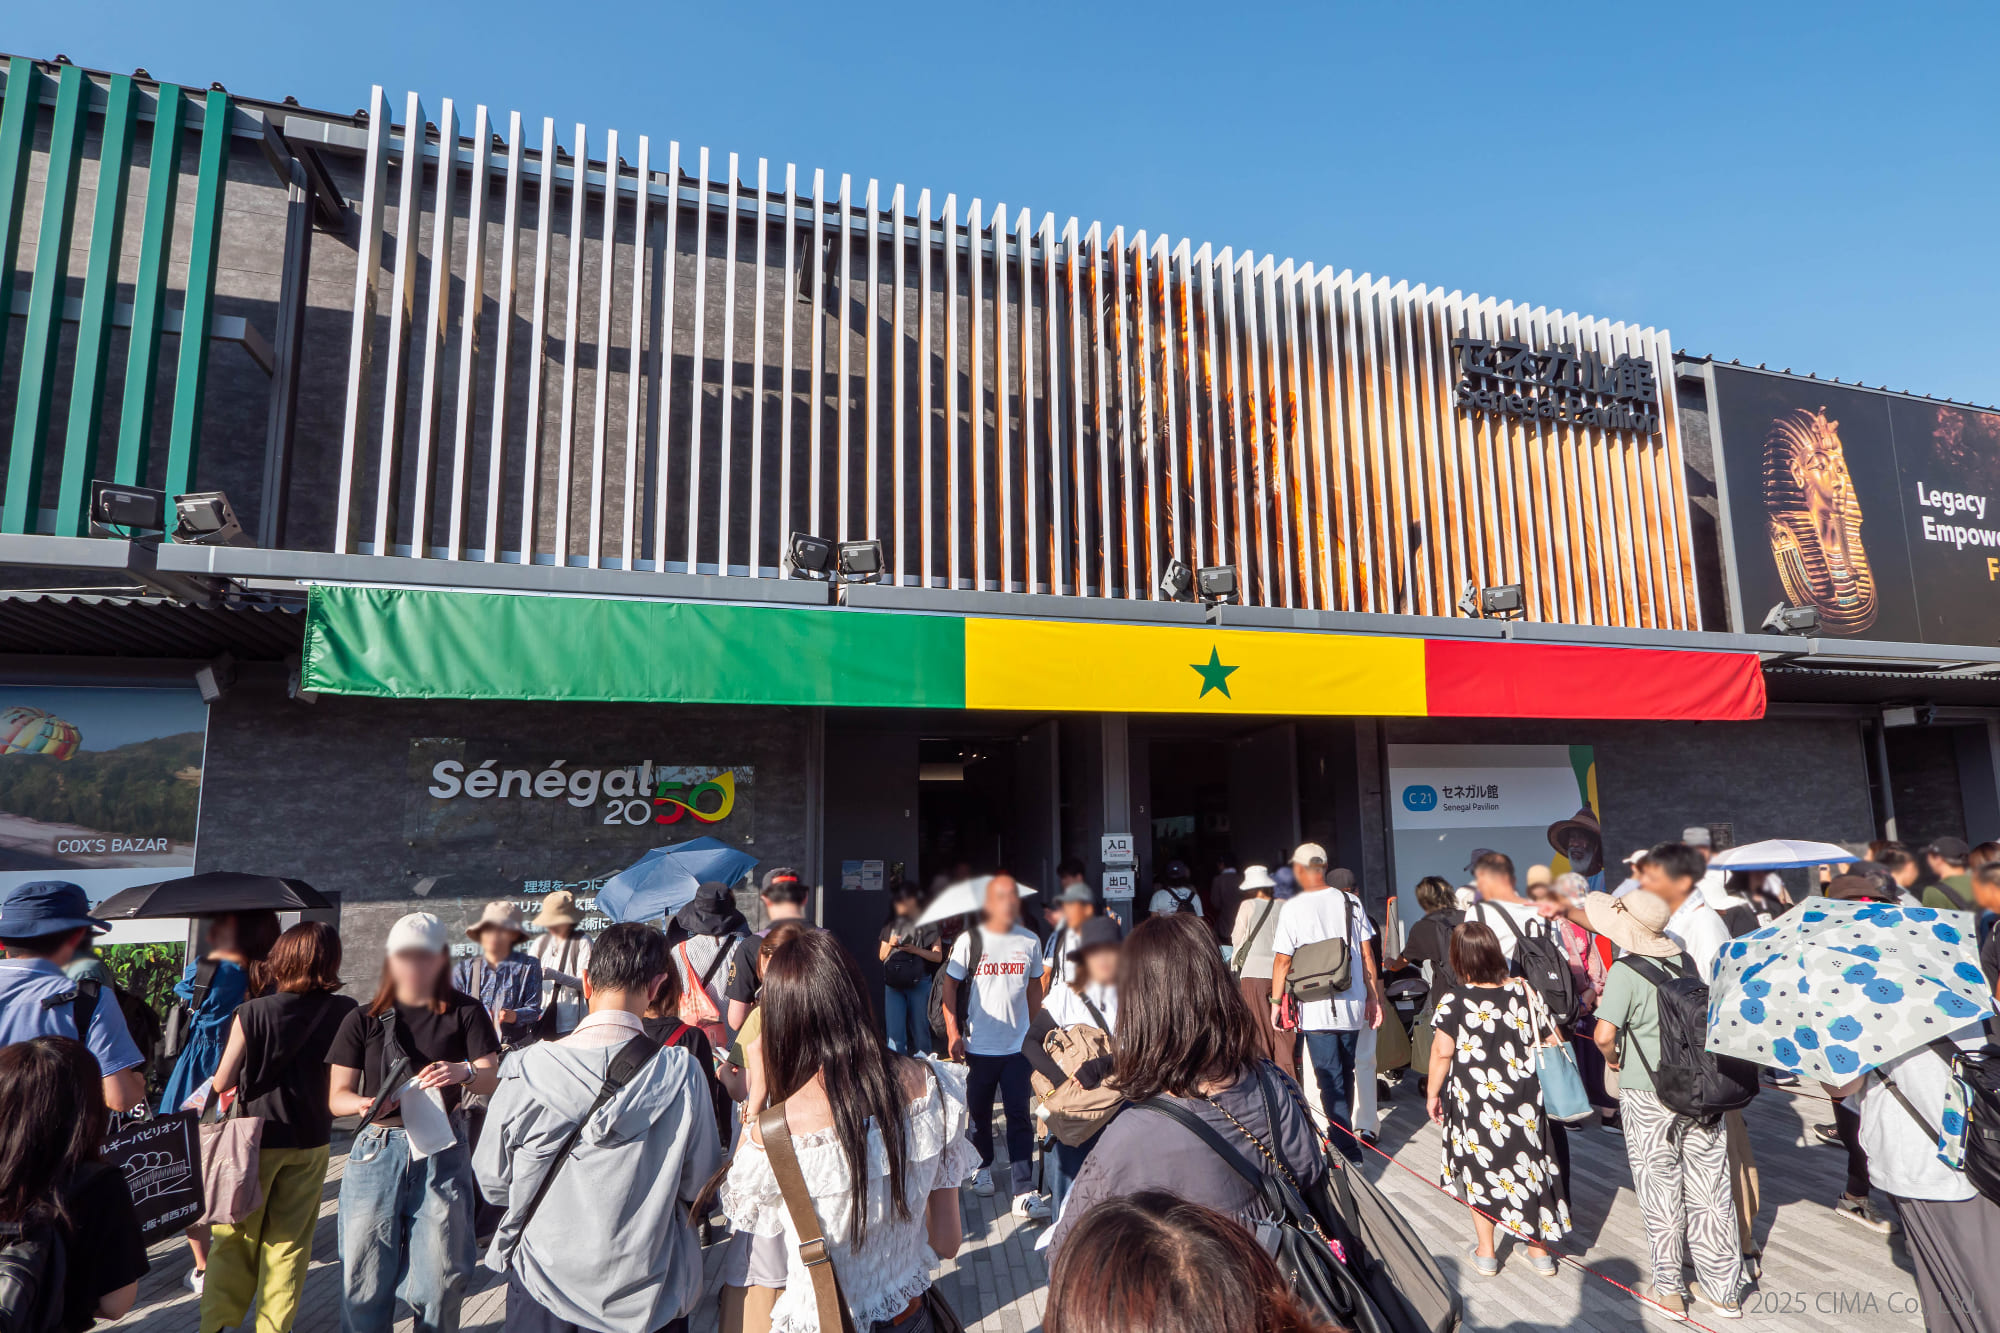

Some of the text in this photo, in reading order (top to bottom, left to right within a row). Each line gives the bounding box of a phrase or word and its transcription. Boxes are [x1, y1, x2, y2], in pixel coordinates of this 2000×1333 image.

[1451, 330, 1656, 402] セネガル館
[1455, 380, 1660, 434] Senegal Pavilion
[1917, 481, 1986, 519] Legacy
[1986, 557, 2000, 581] F
[428, 759, 653, 807] Sénégal
[1409, 793, 1432, 804] C 21
[1442, 785, 1499, 799] セネガル館
[1443, 803, 1500, 812] Senegal Pavilion
[57, 838, 168, 853] COX'S BAZAR
[1108, 840, 1126, 849] 入口
[523, 879, 609, 893] 理想を一つに
[1110, 876, 1127, 886] 出口
[984, 963, 999, 976] COQ
[1000, 963, 1025, 975] SPORTIF
